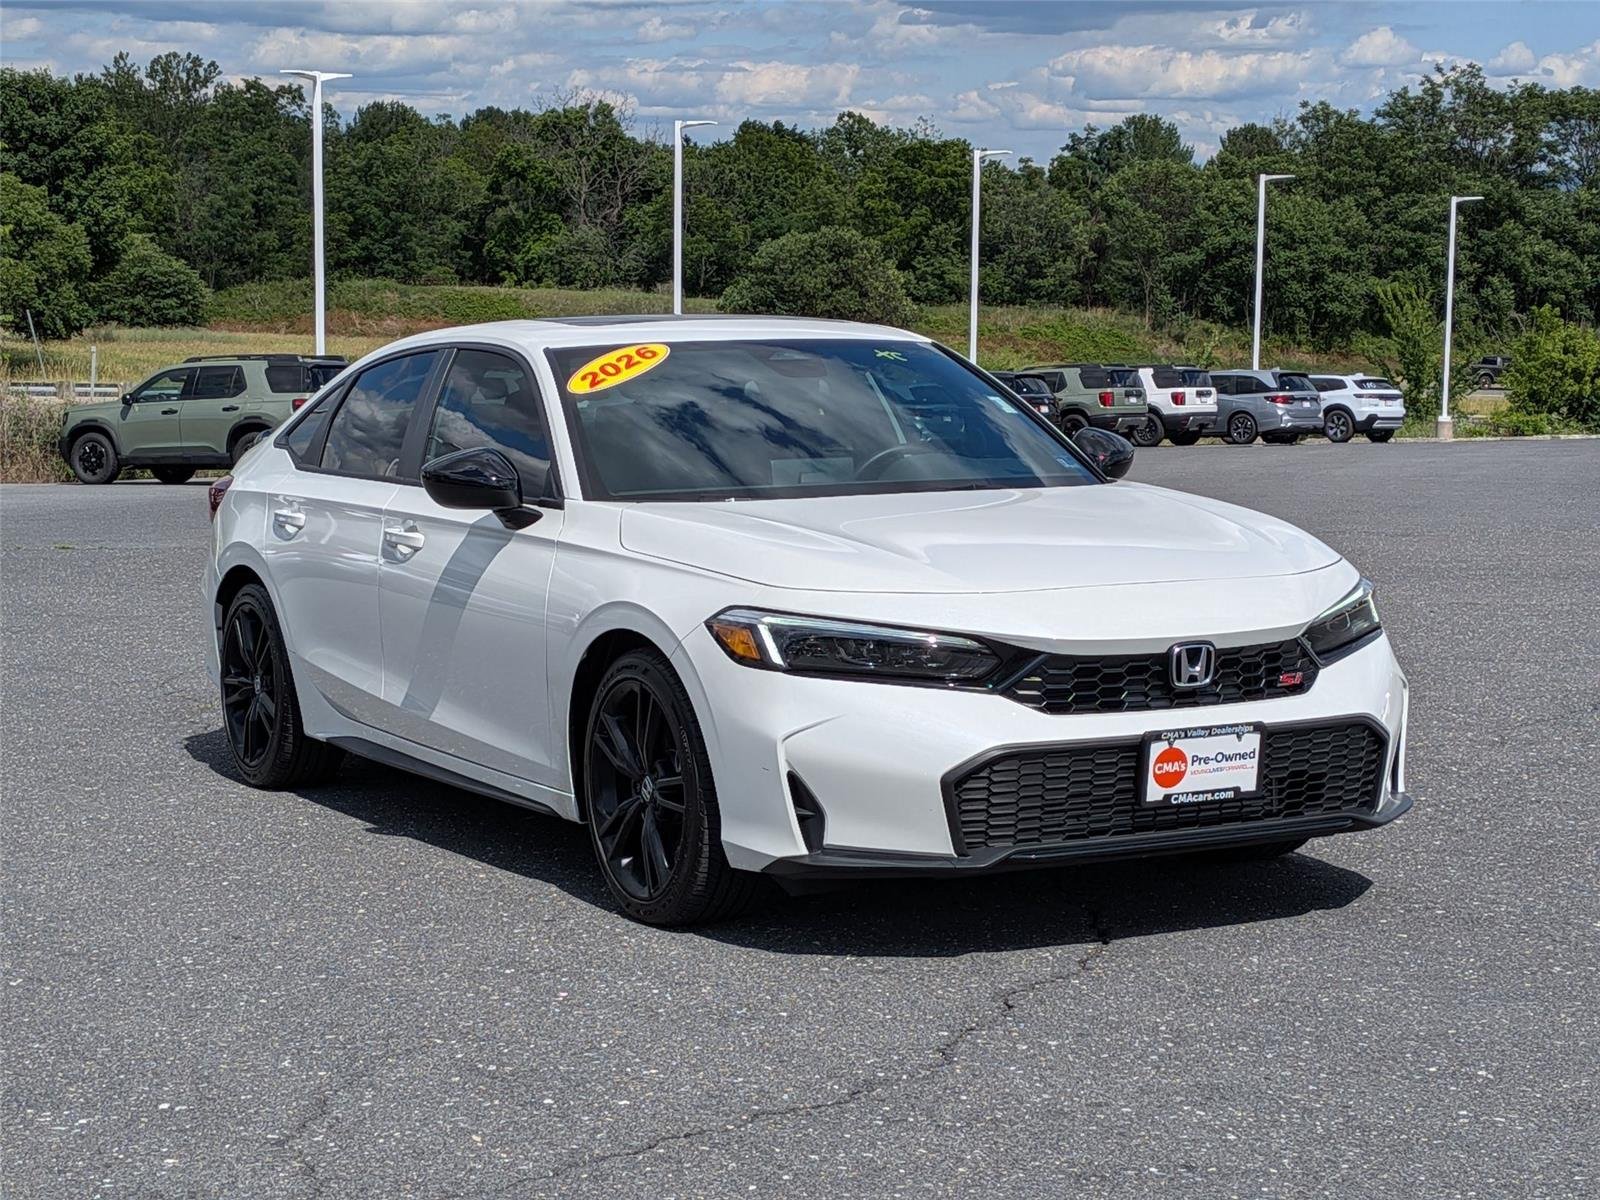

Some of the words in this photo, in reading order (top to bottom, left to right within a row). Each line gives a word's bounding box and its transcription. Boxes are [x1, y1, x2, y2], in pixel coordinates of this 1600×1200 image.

[580, 346, 659, 389] 2026
[1161, 730, 1186, 740] CMA's
[1187, 727, 1210, 739] Valley
[1211, 724, 1254, 736] Dealerships
[1191, 748, 1256, 766] Pre-Owned
[1154, 761, 1186, 775] CMA's
[1171, 790, 1235, 804] CMAcars.com
